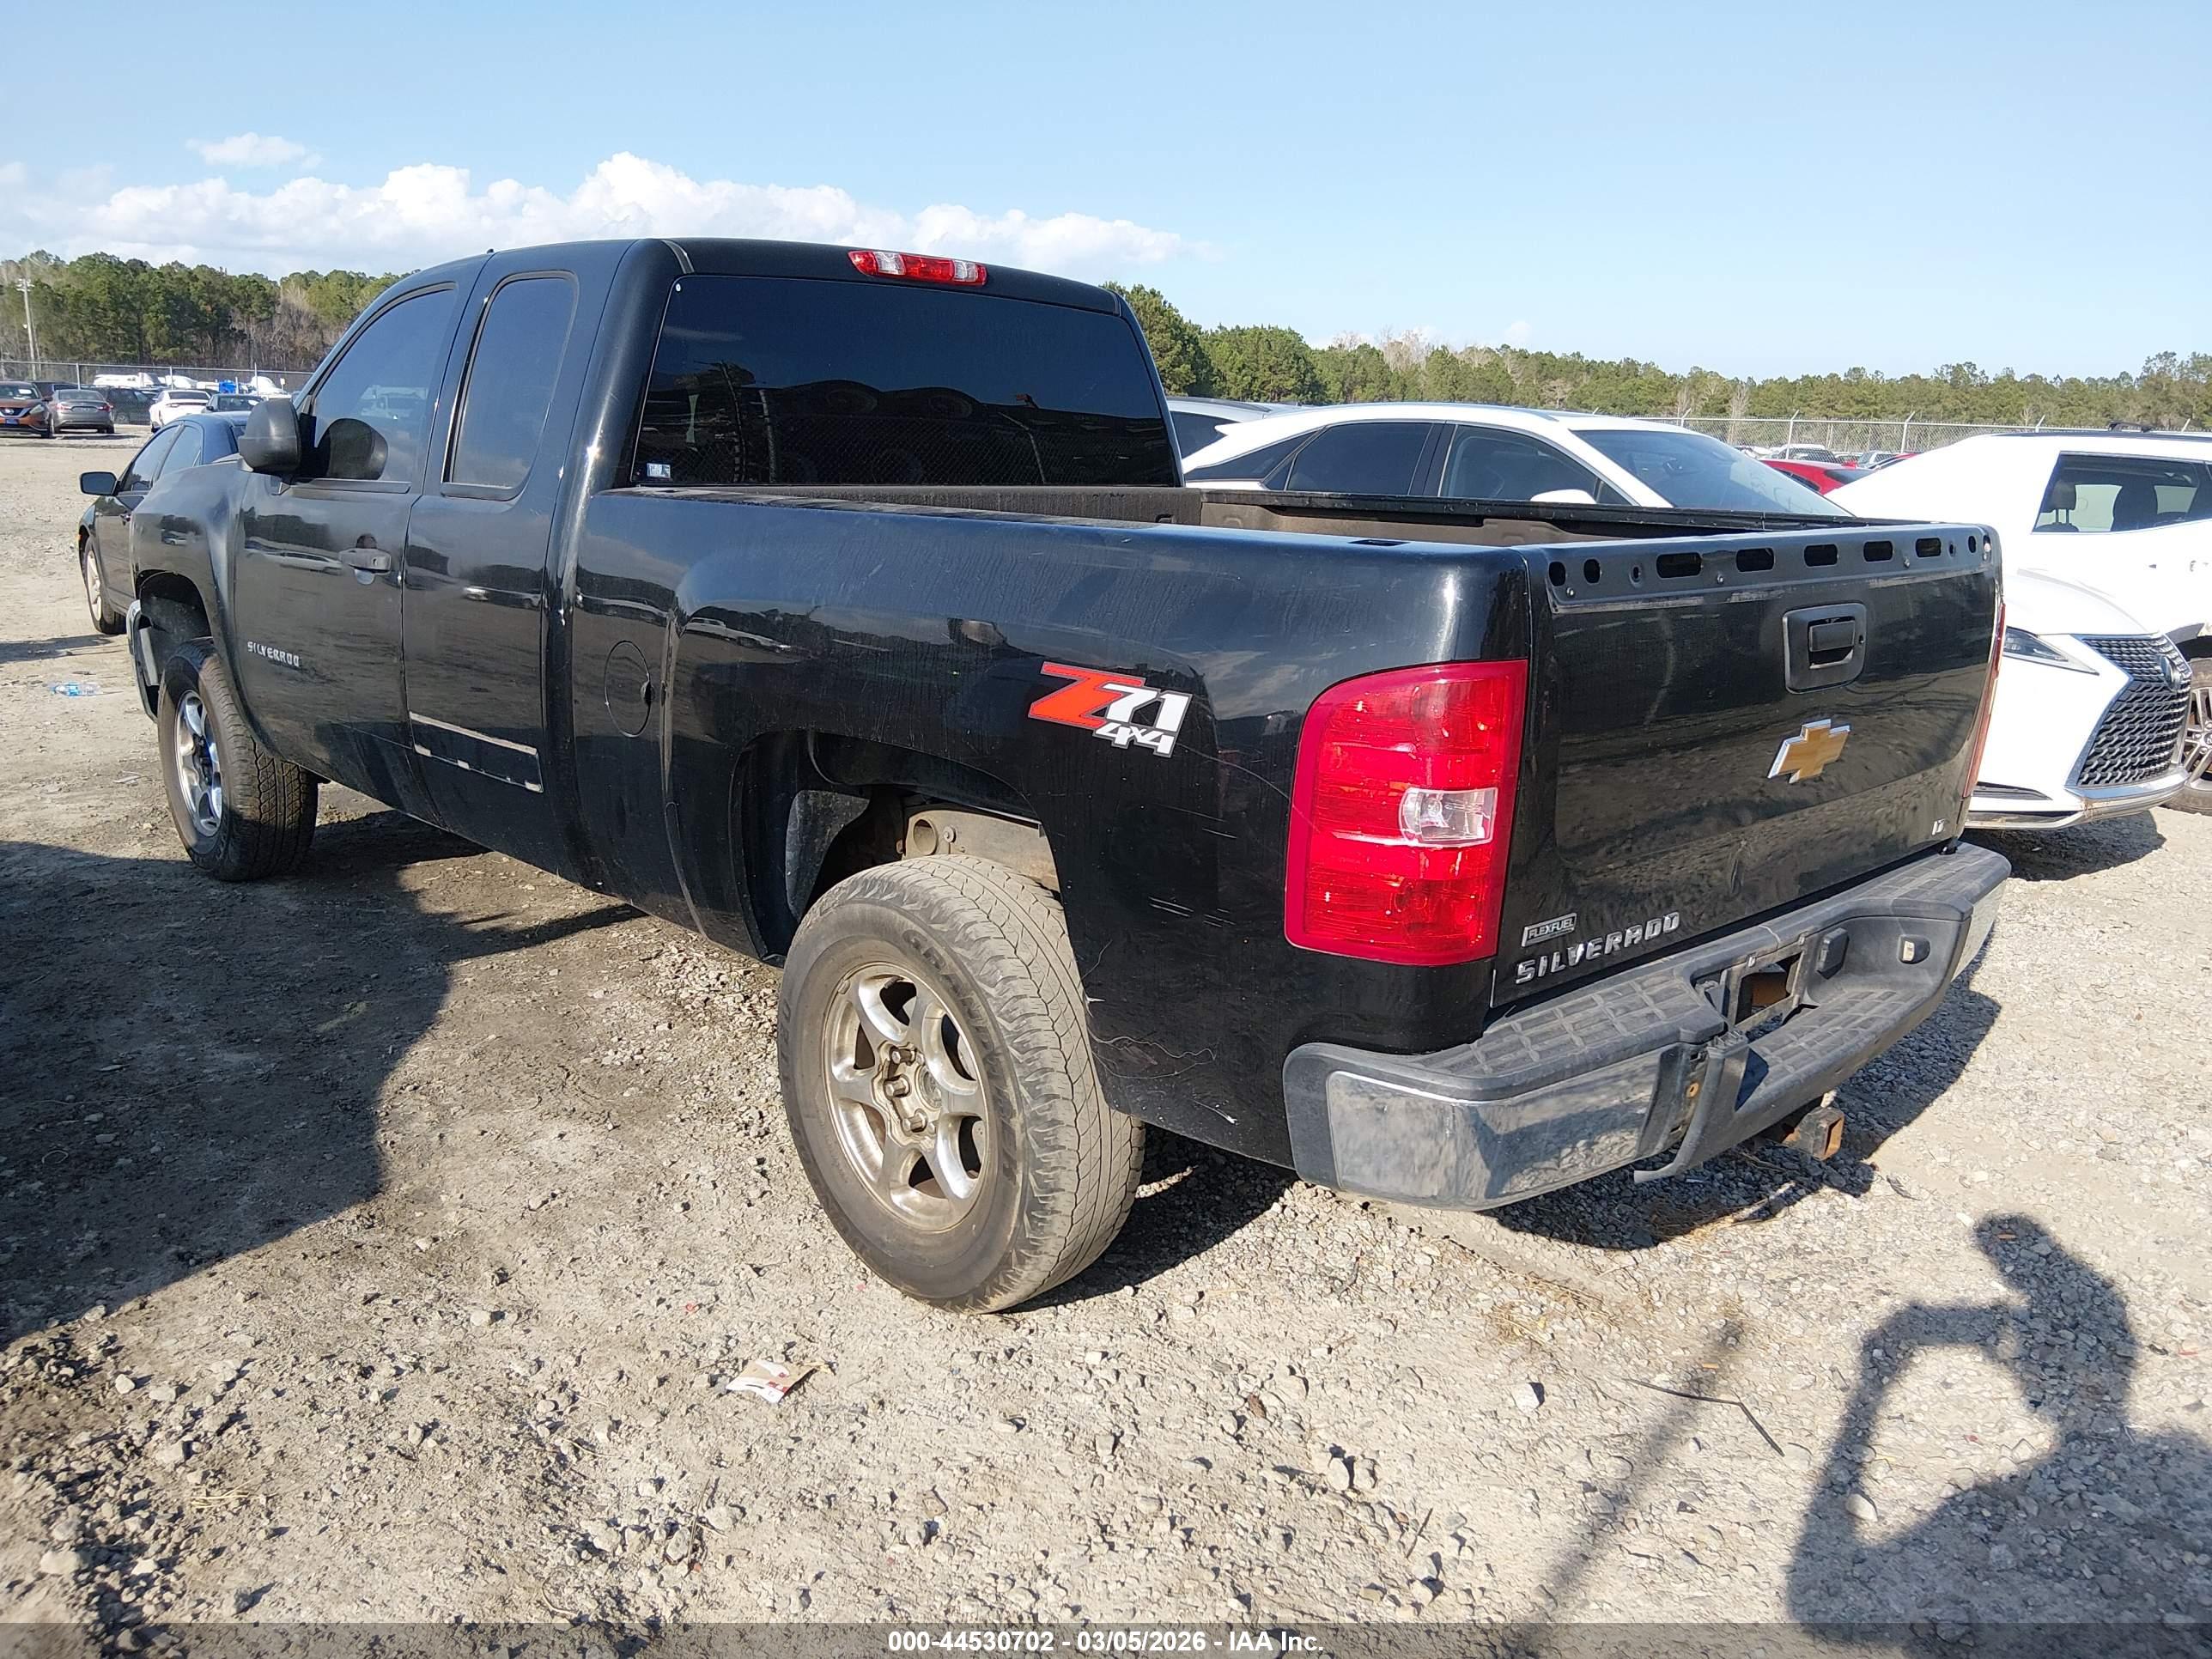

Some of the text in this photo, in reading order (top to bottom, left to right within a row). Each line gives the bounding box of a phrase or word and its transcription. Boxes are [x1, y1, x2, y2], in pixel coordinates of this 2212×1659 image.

[246, 641, 301, 667] SILVERADO
[1028, 661, 1193, 733] Z71
[1515, 911, 1680, 984] SILVERADO
